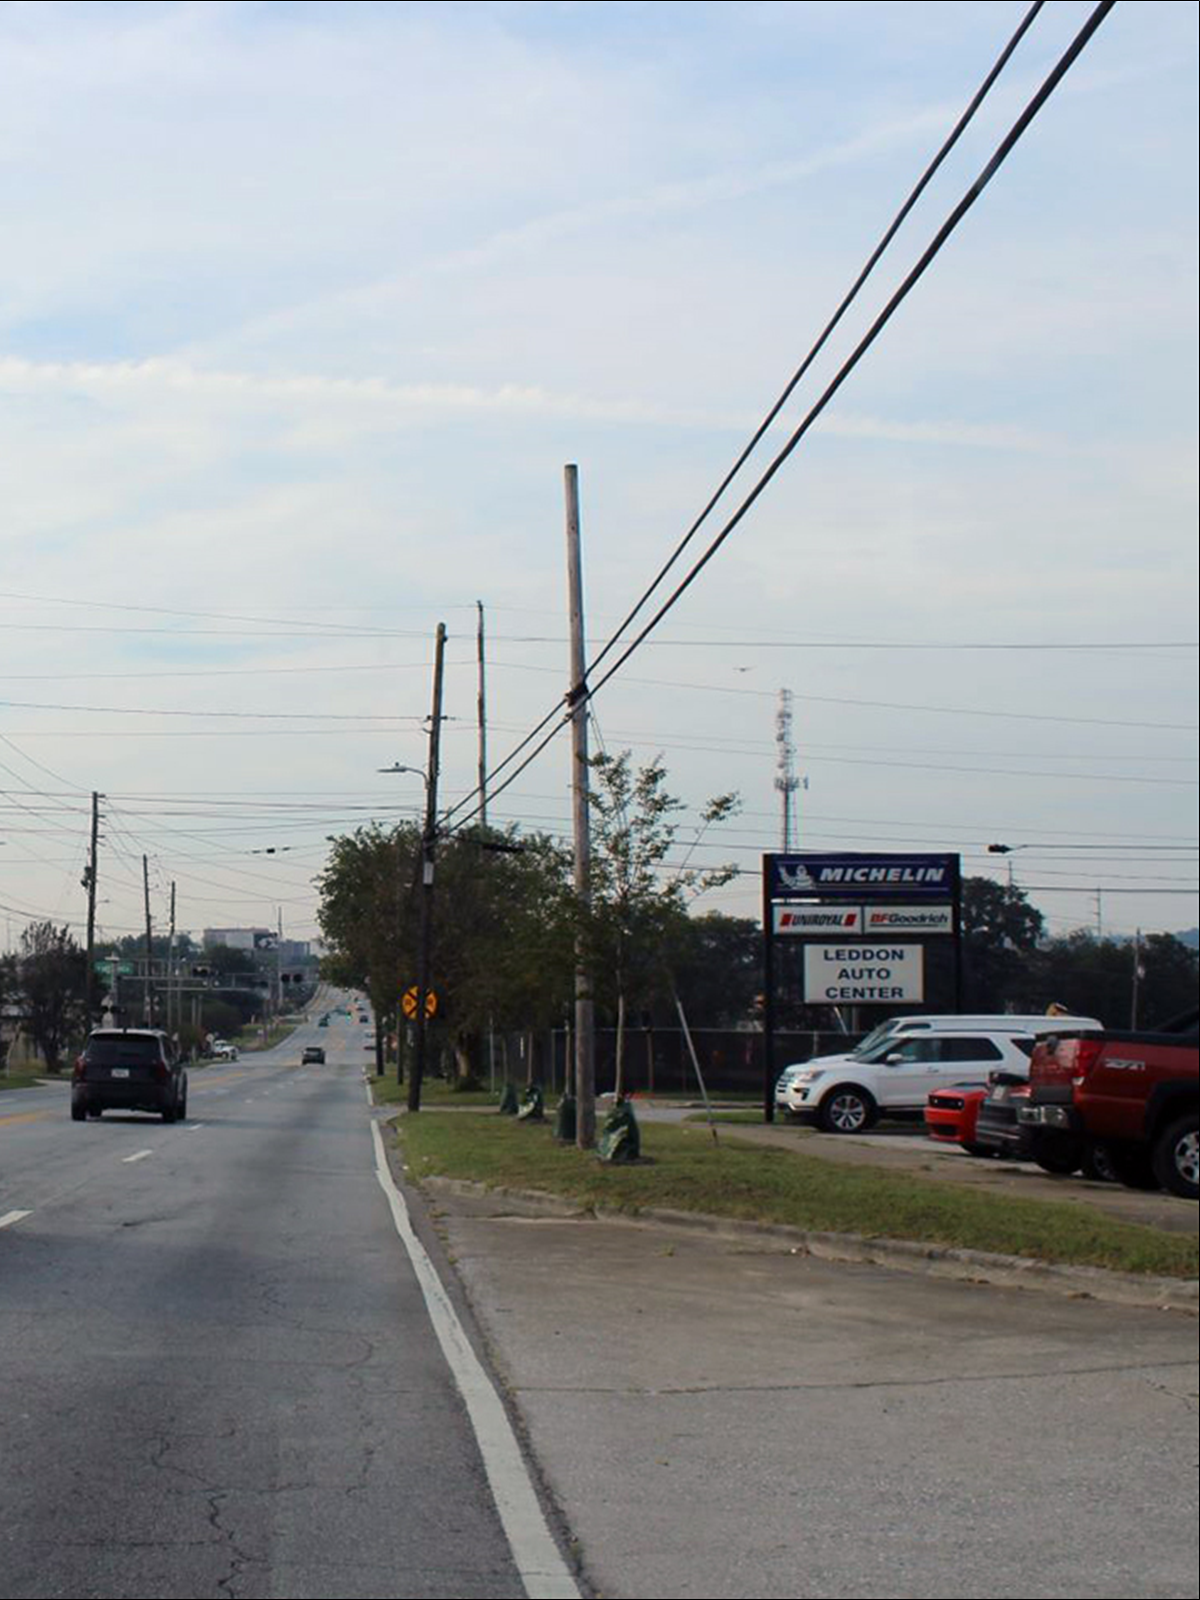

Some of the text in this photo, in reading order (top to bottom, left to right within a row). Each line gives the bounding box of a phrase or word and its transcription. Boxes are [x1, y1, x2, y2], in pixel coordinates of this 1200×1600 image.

[820, 868, 944, 881] MICHELIN
[792, 913, 843, 926] UNIROYAL
[870, 912, 948, 923] BFGoodrich
[823, 949, 904, 961] LEDDON
[837, 967, 891, 980] AUTO
[825, 986, 904, 999] CENTER
